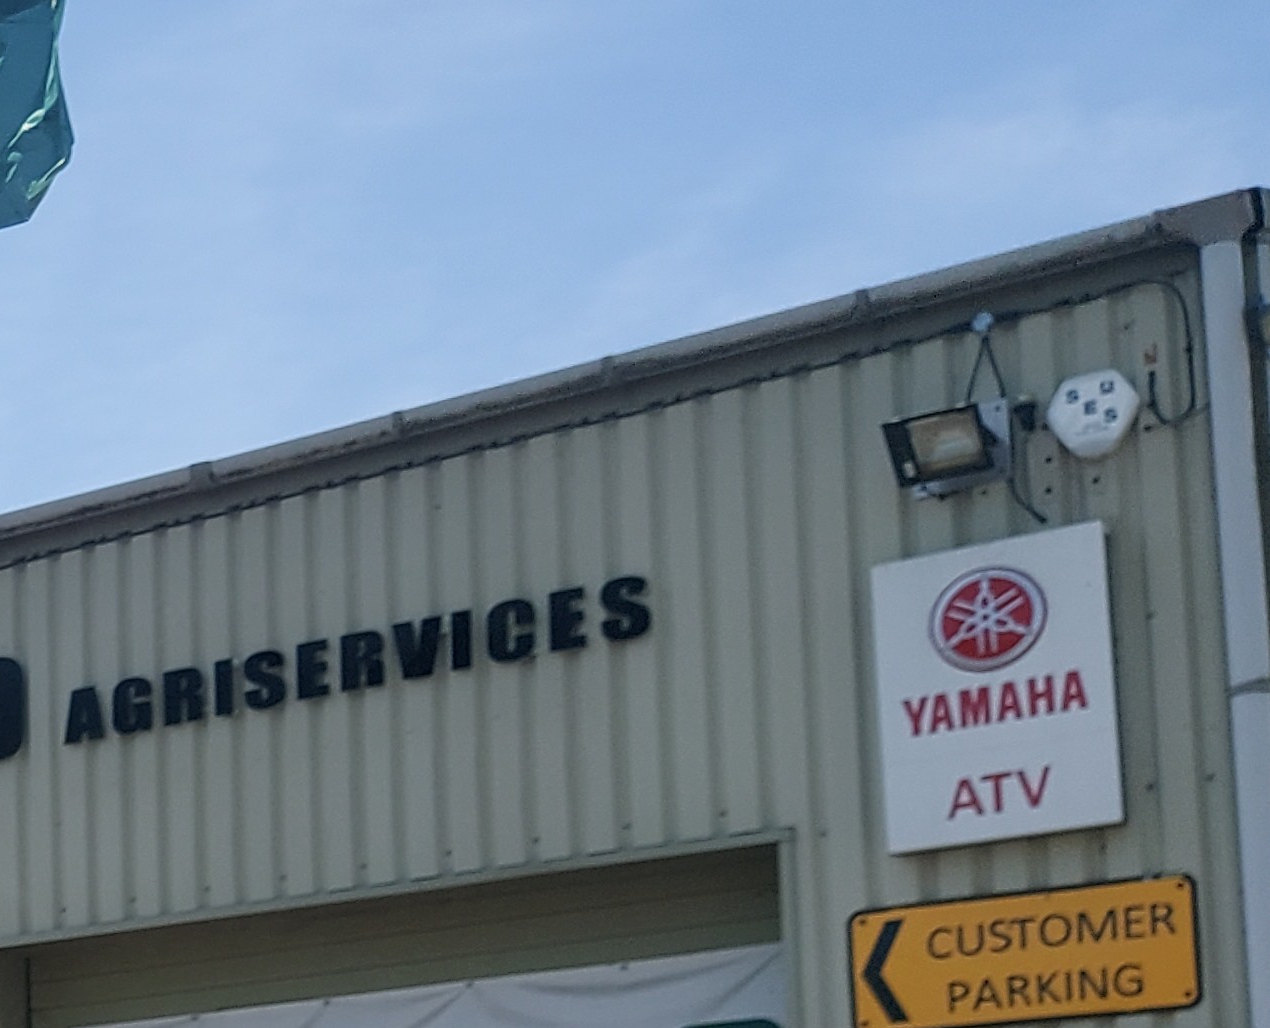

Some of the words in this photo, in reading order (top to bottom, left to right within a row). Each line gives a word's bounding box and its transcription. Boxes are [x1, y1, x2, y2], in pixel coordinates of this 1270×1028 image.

[65, 576, 653, 745] AGRISERVICES
[903, 669, 1090, 738] YAMAHA
[947, 765, 1051, 822] ATV
[927, 902, 1177, 961] CUSTOMER
[947, 962, 1145, 1013] PARKING
